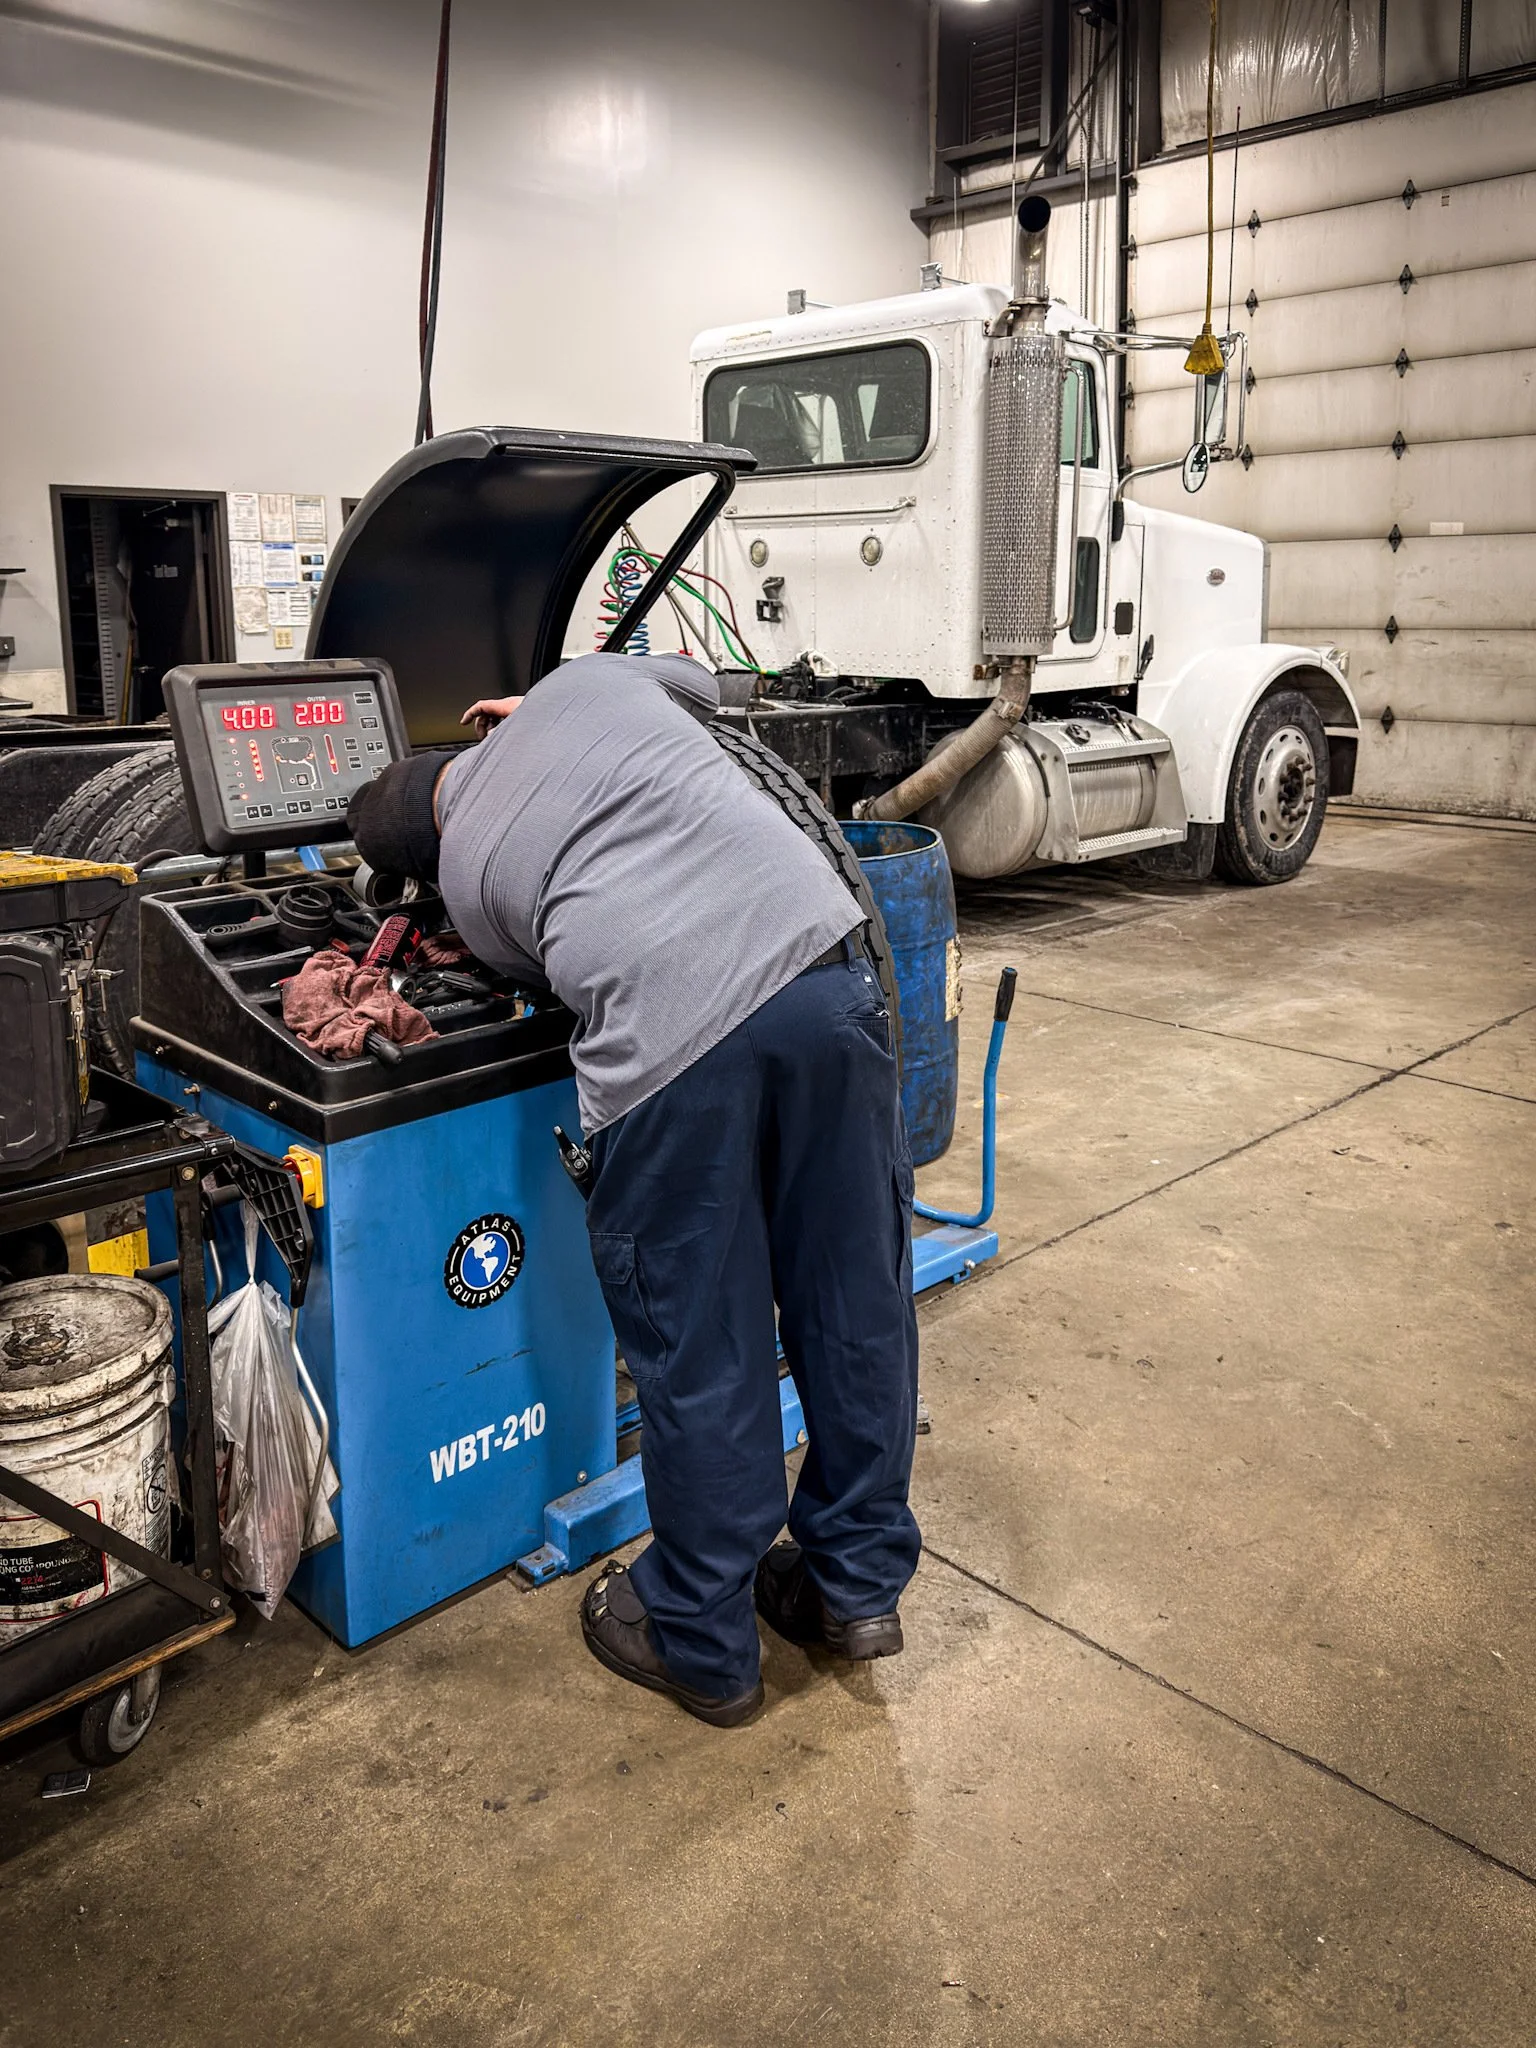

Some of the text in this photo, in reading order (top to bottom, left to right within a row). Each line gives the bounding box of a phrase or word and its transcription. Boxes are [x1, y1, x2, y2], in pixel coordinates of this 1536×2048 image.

[223, 707, 273, 729] 4.00
[295, 702, 342, 725] 2.00
[460, 1217, 511, 1246] ATLAS
[448, 1254, 521, 1304] EQUIPMENT
[429, 1402, 546, 1484] WBT-210
[10, 1556, 34, 1566] TUBE
